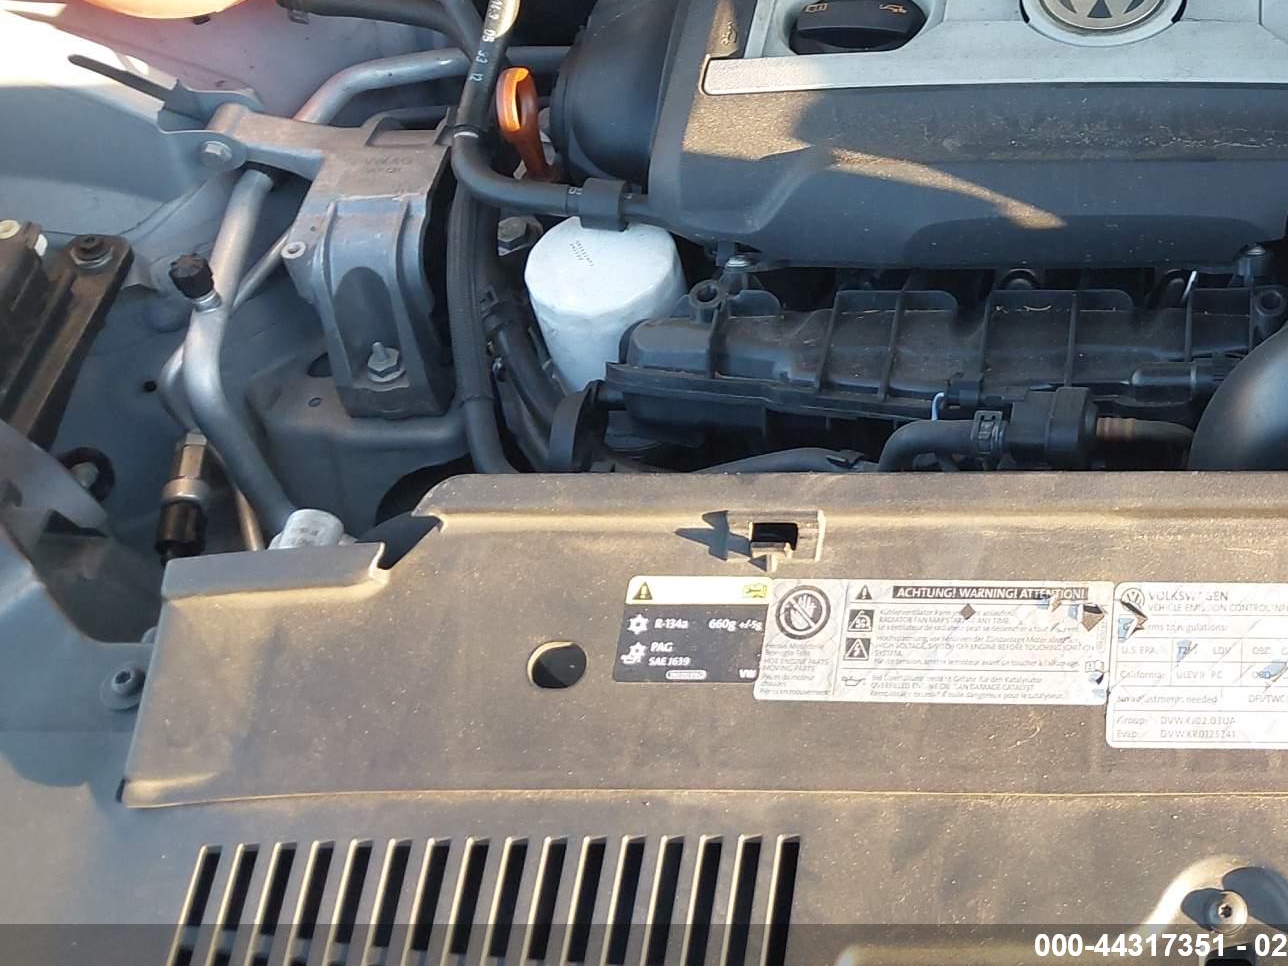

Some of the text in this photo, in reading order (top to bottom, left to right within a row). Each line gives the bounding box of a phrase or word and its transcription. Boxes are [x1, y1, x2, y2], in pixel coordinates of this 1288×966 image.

[896, 587, 957, 598] ACHTUNG!
[958, 587, 1018, 599] WARNING!
[654, 618, 763, 633] R-134a 660g +/-5g
[650, 641, 674, 653] PAG
[648, 656, 667, 667] SAE
[739, 668, 758, 679] VW
